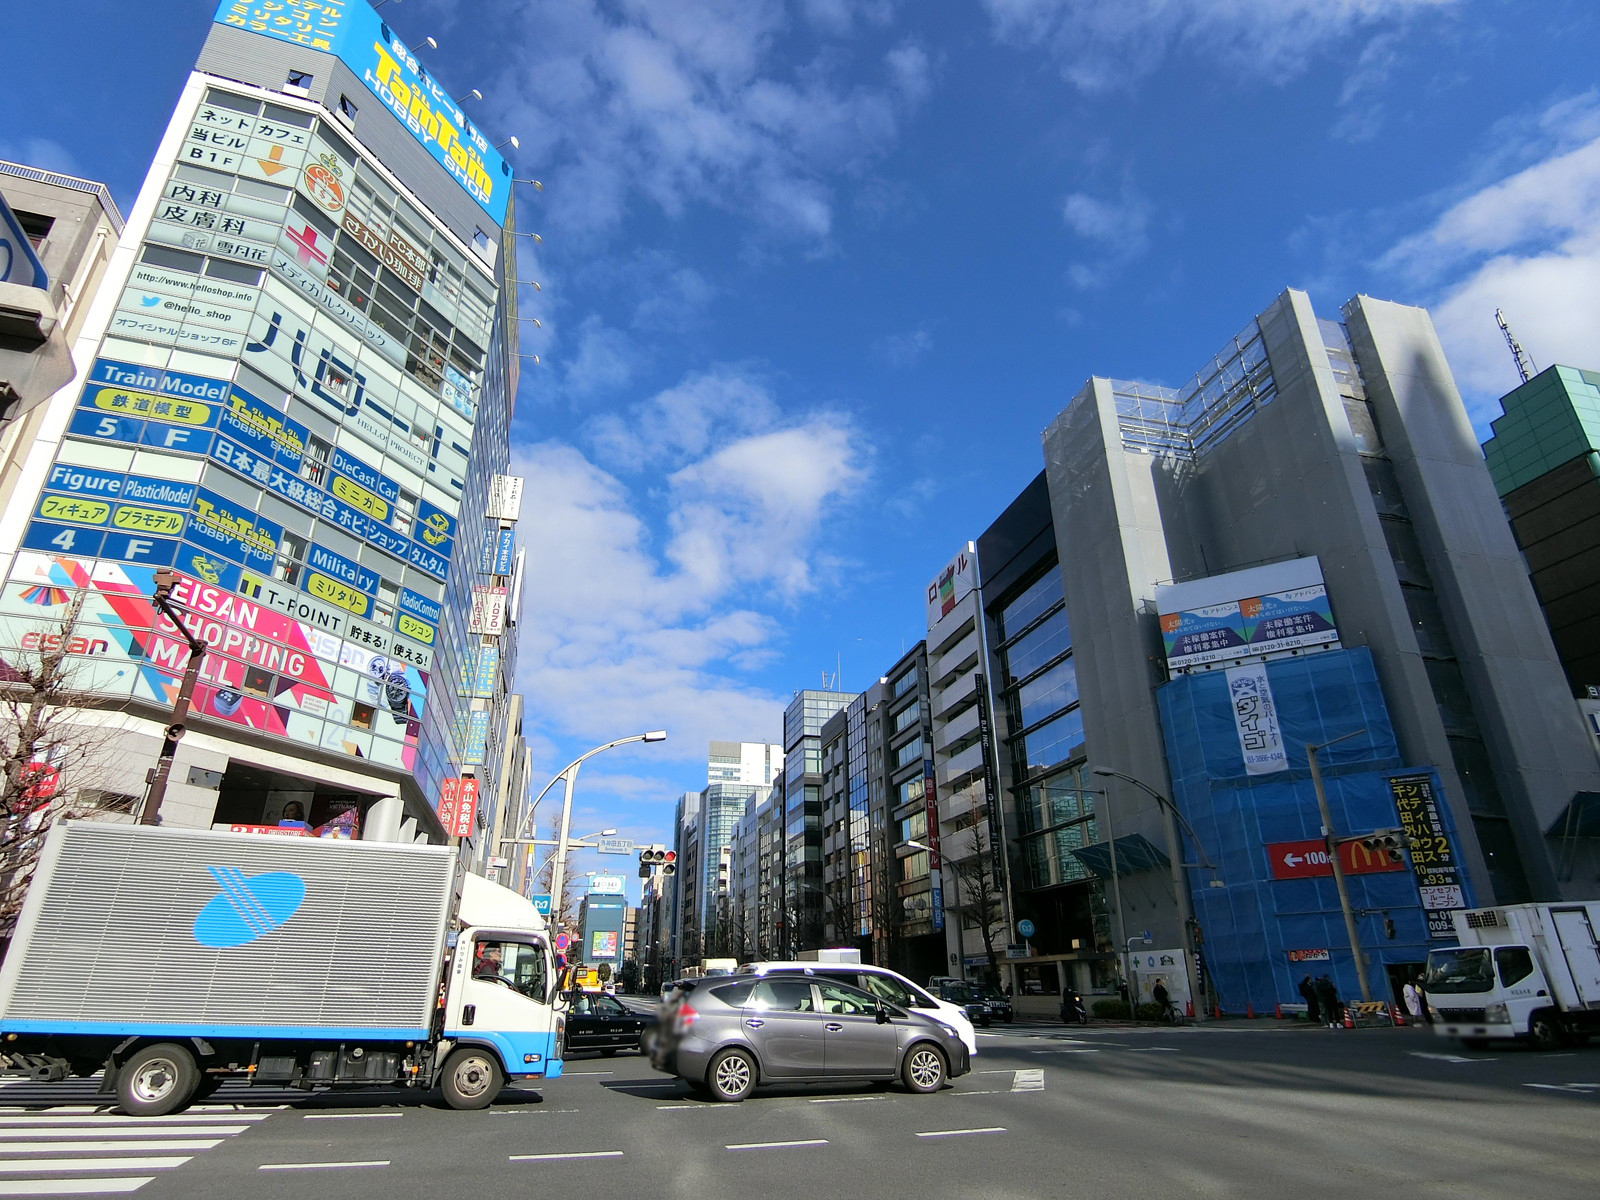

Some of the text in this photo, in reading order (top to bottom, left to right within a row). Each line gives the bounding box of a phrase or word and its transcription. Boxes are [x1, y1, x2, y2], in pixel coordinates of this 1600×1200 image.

[231, 3, 335, 38] ミリタリー
[242, 0, 338, 27] ジコン
[225, 14, 331, 51] カラー工具
[373, 41, 493, 198] TamTam
[191, 128, 246, 149] 当ビル
[364, 68, 490, 204] HOBBY SHOP
[171, 185, 223, 208] 内科
[162, 206, 246, 236] 皮膚科
[217, 240, 269, 262] 雪月花
[344, 216, 422, 291] さかい珈琲
[390, 233, 426, 272] FC本部
[136, 271, 253, 302] http://www.helloshop.info
[163, 301, 232, 322] @hello_shop
[273, 258, 386, 346] メディカルクリニック
[116, 318, 239, 347] オフィシャルショップ6F
[104, 365, 227, 400] Train Model
[111, 393, 193, 419] 鉄道模型
[95, 417, 191, 447] 5 F
[223, 414, 301, 462] HOBBY SHOP
[229, 394, 304, 456] TamTam
[390, 440, 425, 467] PROJECT
[49, 466, 121, 493] Figure
[333, 453, 397, 501] DieCast Car
[124, 480, 193, 505] PlasticModel
[338, 482, 387, 514] ミニカー
[44, 500, 106, 520] フィギュア
[117, 510, 180, 530] プラモデル
[188, 520, 273, 562] HOBBY SHOP
[195, 497, 277, 556] TamTam
[51, 529, 154, 560] 4 F
[312, 549, 375, 592] Military
[170, 577, 259, 629] EISAN
[313, 581, 363, 608] ミリタリー
[492, 587, 506, 595] 6F
[1293, 587, 1324, 598] アドバンス
[268, 589, 341, 632] T-POINT
[1209, 604, 1239, 615] アドバンス
[1264, 614, 1313, 629] 未稼働案件
[159, 606, 305, 676] SHOPPING
[349, 625, 388, 651] 貯まる!
[402, 618, 432, 640] ラジコン
[1181, 629, 1227, 645] 未稼働案件
[1266, 624, 1315, 639] 権利募集中
[393, 642, 429, 667] 使える!
[1183, 639, 1229, 654] 権利募集中
[1260, 639, 1301, 651] 0120-31-8210
[150, 638, 233, 687] MALL
[1177, 654, 1216, 666] 0120-31-8210
[1233, 680, 1253, 688] DAIGO
[1236, 695, 1267, 751] ダイゴ
[457, 781, 475, 835] 永山免税店
[1392, 786, 1425, 864] 千代田外神田
[1406, 785, 1438, 863] シティハウス
[1421, 886, 1459, 895] コンセプト
[1428, 900, 1458, 908] オープン
[933, 890, 942, 924] LAWSON
